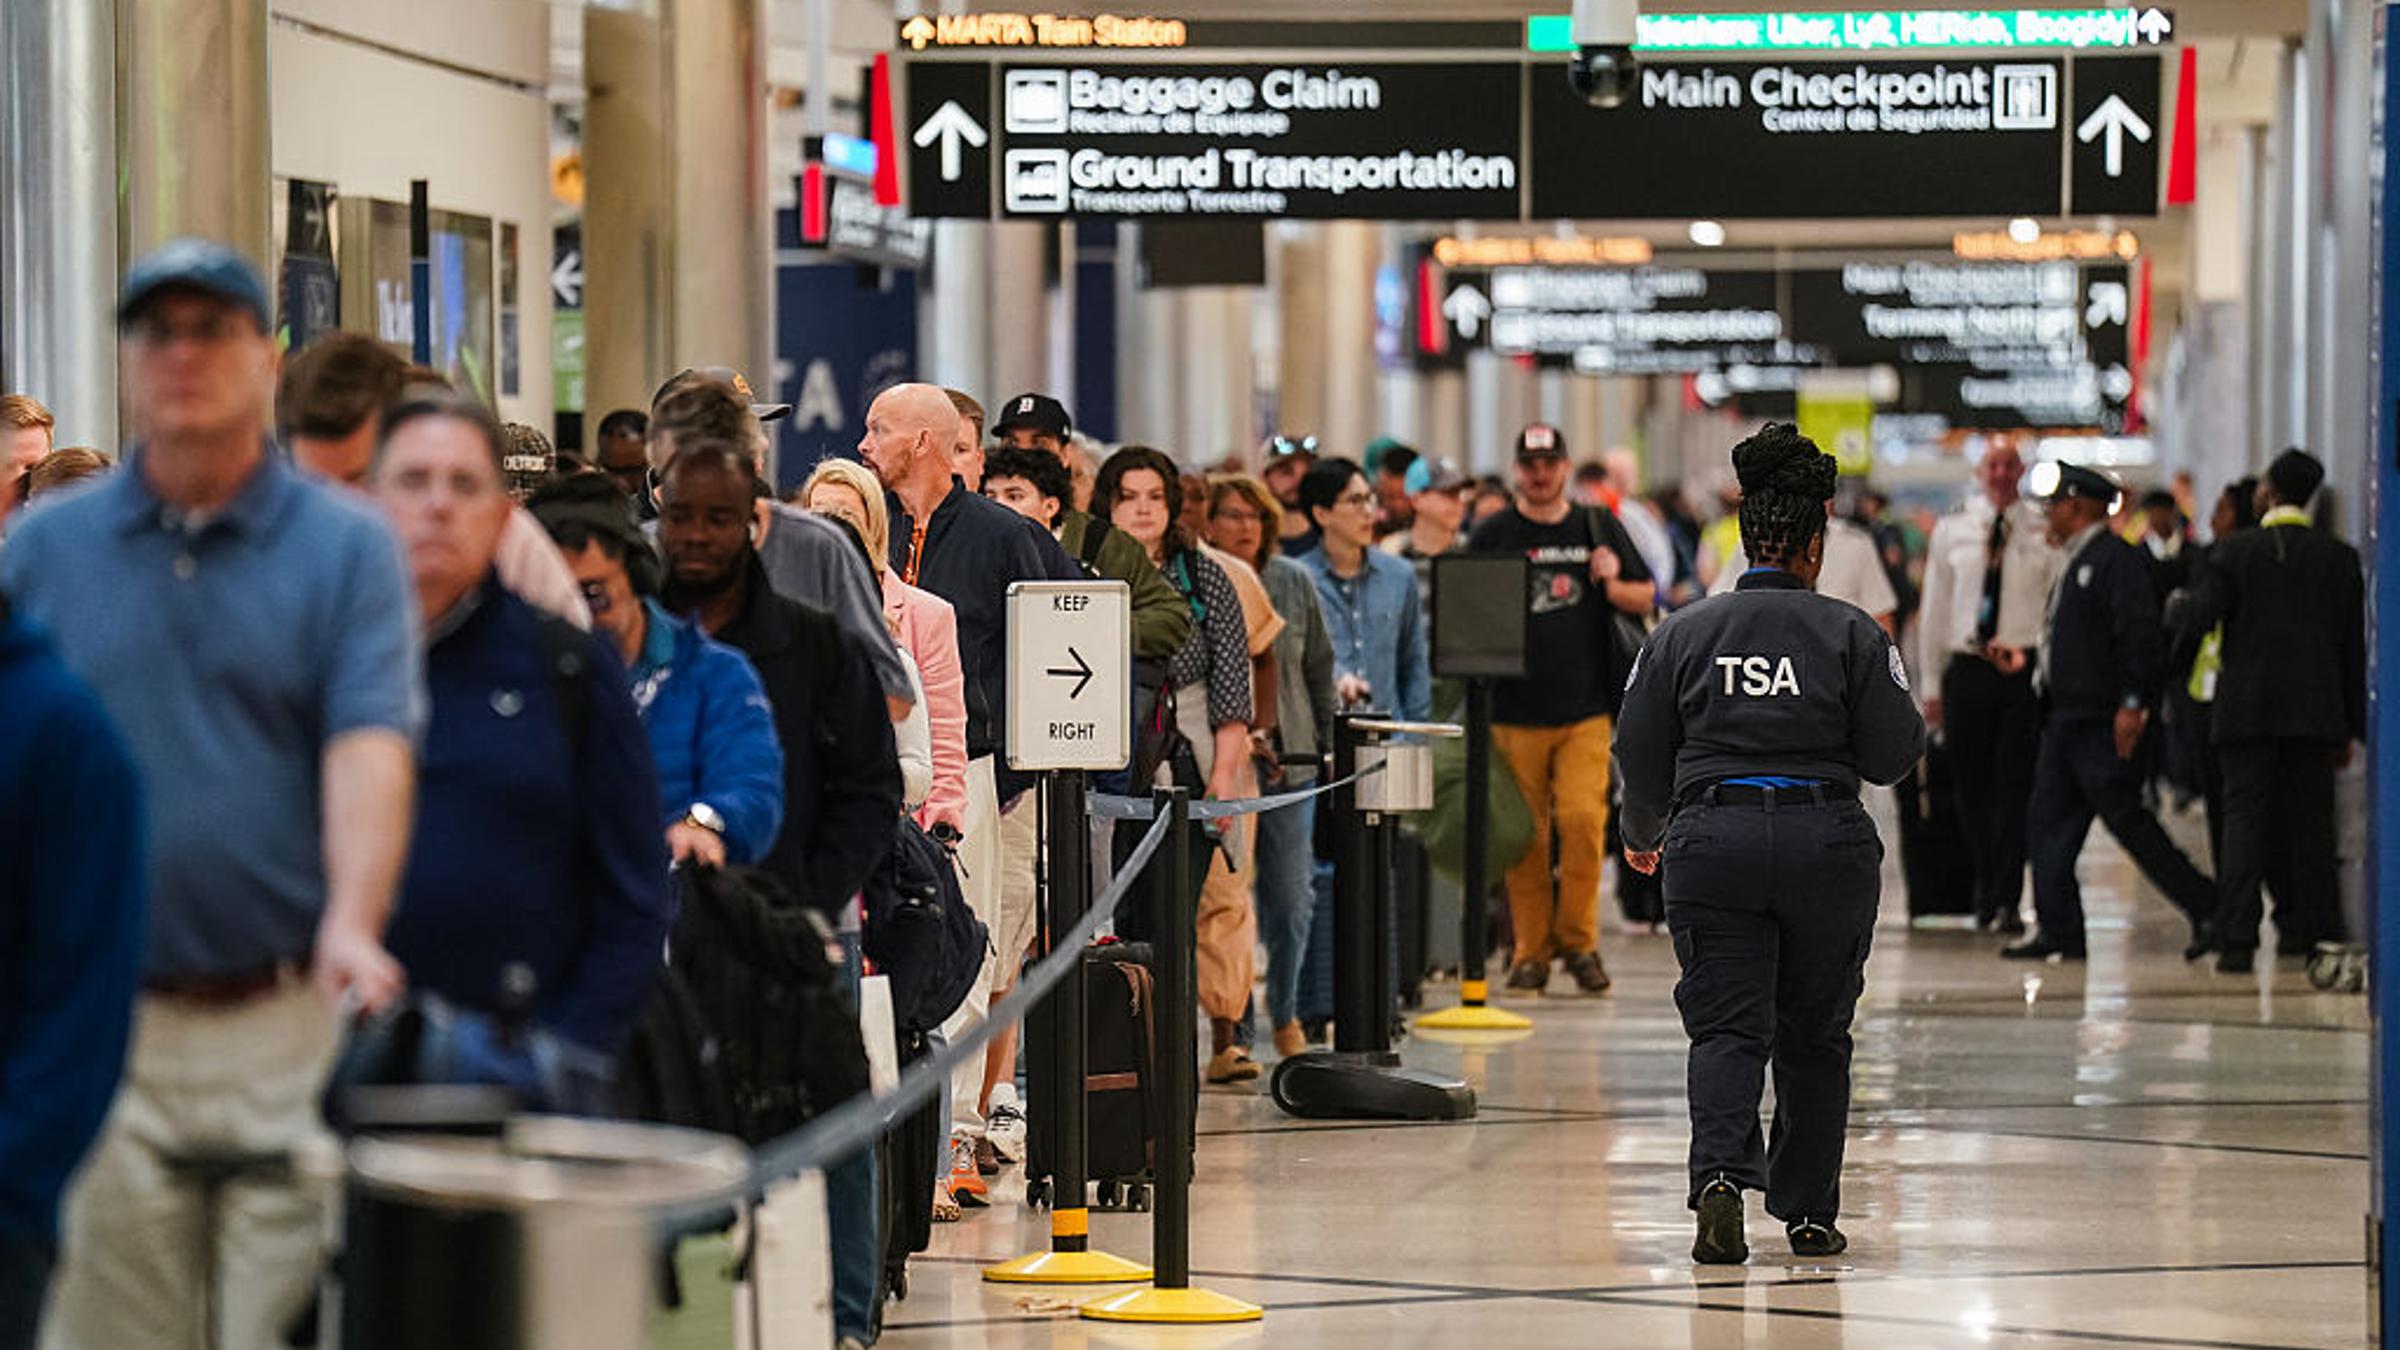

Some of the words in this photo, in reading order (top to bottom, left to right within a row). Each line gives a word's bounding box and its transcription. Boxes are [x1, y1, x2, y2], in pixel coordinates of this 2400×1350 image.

[937, 13, 1034, 45] MARTA
[1031, 14, 1093, 45] Train
[1094, 13, 1187, 46] Station
[1070, 69, 1255, 115] Baggage
[1261, 69, 1381, 109] Claim
[1643, 68, 1741, 107] Main
[1750, 65, 1991, 112] Checkpoint
[1846, 107, 1877, 131] de
[1070, 148, 1220, 188] Ground
[1224, 148, 1515, 194] Transportation
[1053, 594, 1090, 612] KEEP
[1715, 656, 1801, 696] TSA
[1049, 722, 1096, 741] RIGHT
